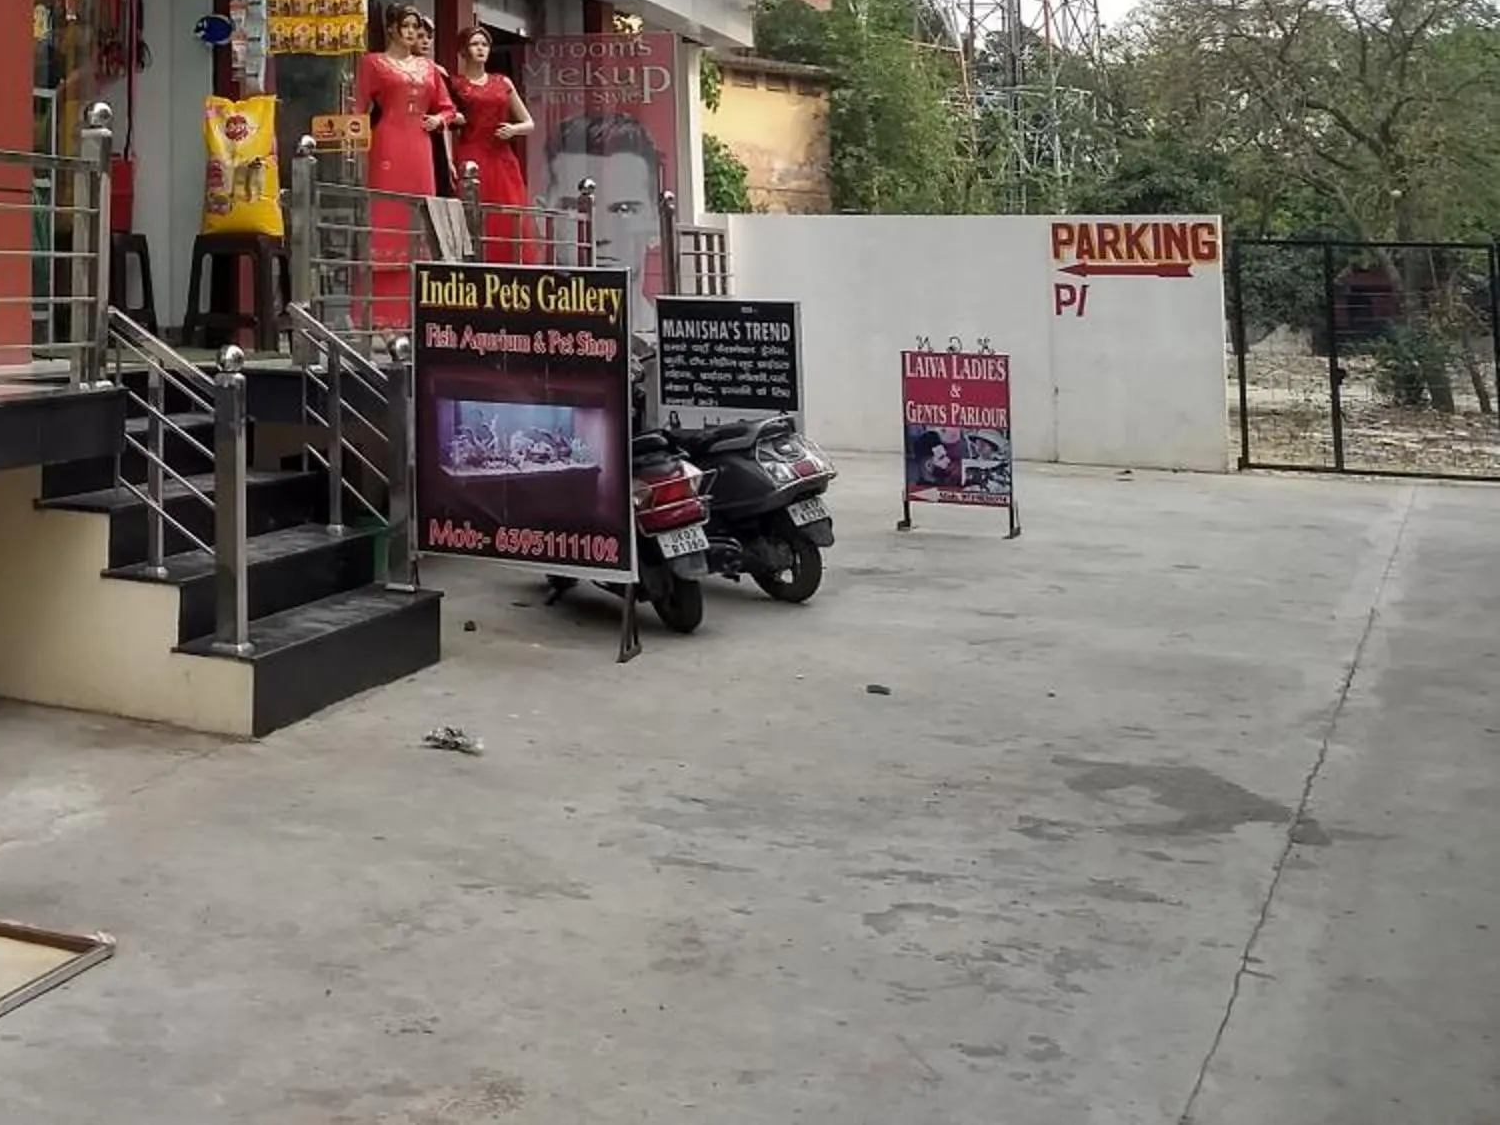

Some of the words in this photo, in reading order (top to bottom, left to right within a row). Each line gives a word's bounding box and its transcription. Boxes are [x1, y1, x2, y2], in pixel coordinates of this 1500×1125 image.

[1051, 222, 1218, 261] PARKING
[419, 270, 479, 308] India
[484, 272, 531, 312] Pets
[537, 274, 624, 325] Gallery
[425, 322, 459, 350] Fish
[533, 330, 546, 355] &
[547, 329, 575, 357] Pet
[575, 330, 618, 362] Shop
[661, 318, 741, 341] MANISHA'S
[743, 321, 792, 343] TREND
[951, 354, 1007, 382] LADIES
[949, 383, 962, 399] &
[905, 400, 947, 424] GENTS
[951, 402, 1009, 428] PARLOUR
